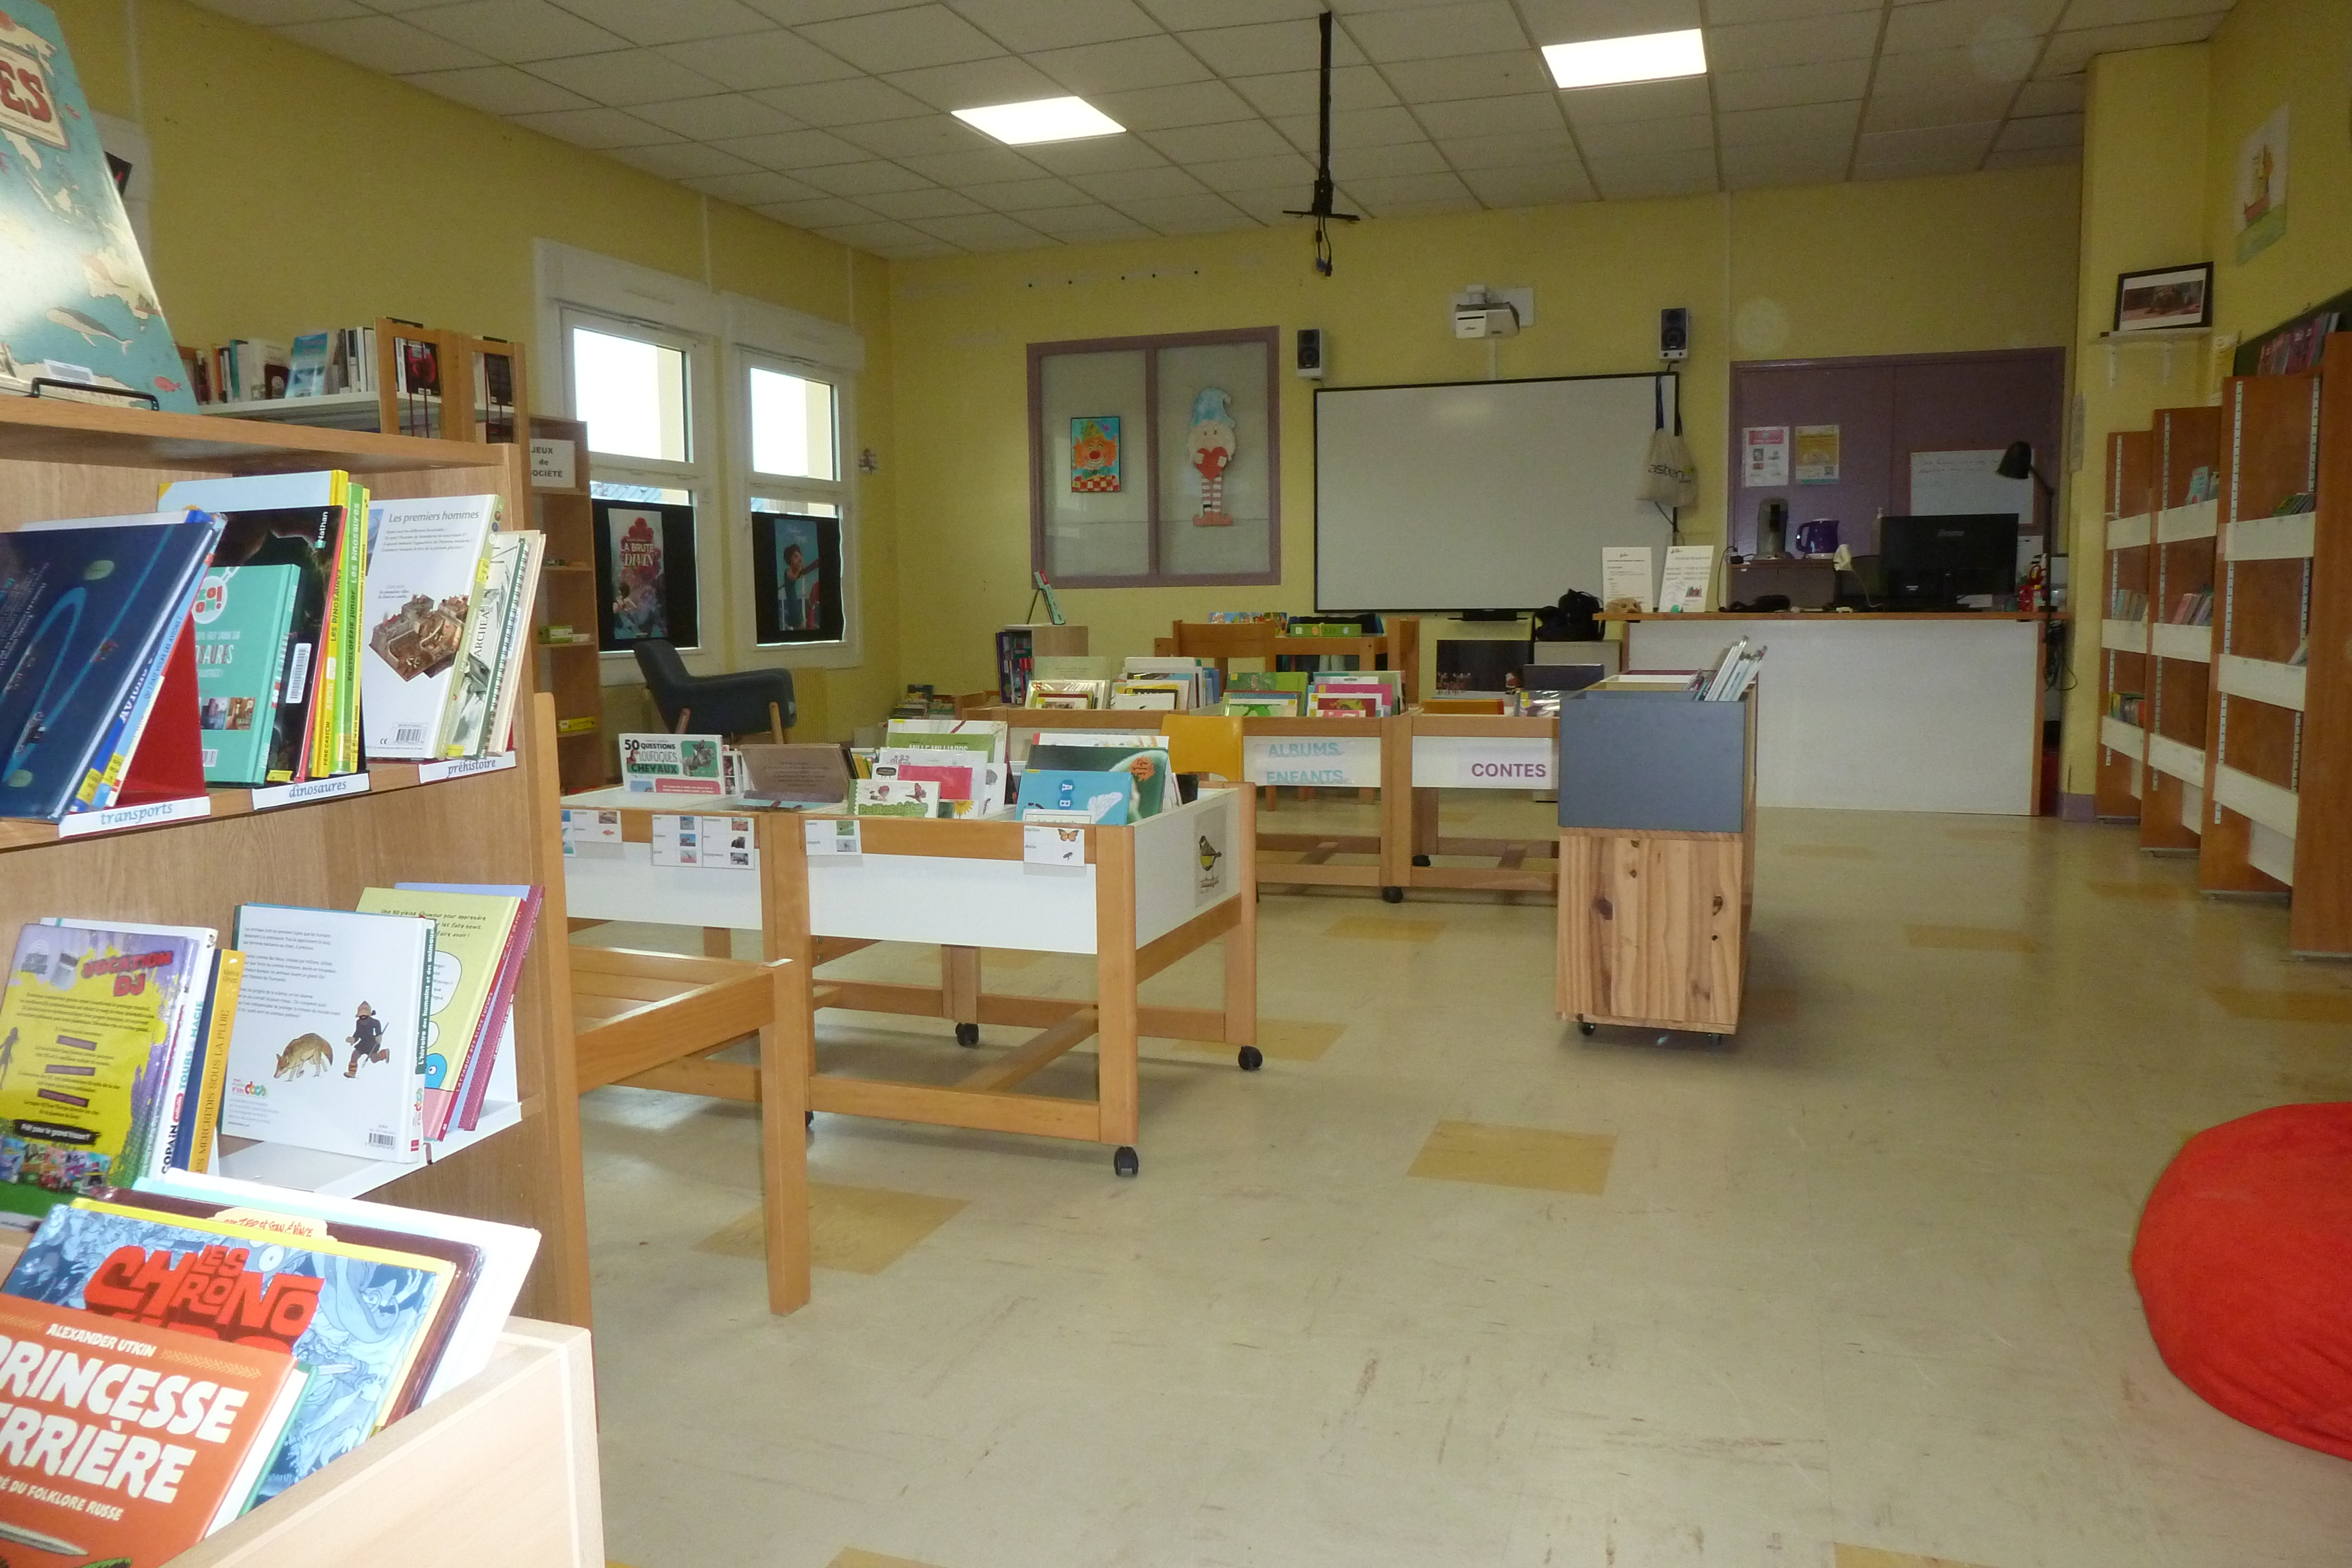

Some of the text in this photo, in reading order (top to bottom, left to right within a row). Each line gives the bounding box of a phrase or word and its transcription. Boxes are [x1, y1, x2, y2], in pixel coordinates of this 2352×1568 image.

[532, 469, 564, 478] OCIÉTÉ
[318, 511, 329, 542] Nathan
[389, 511, 480, 524] Les premiers hommes
[351, 503, 360, 561] Dinosaures
[632, 543, 654, 553] BRUTE
[624, 553, 654, 567] DIVIN
[624, 739, 640, 750] 50
[1269, 742, 1339, 757] ALBUMS
[447, 757, 496, 778] préhistoire
[639, 751, 677, 763] LOUFOQUES
[631, 764, 677, 774] CHEVAUX
[1266, 769, 1343, 785] ENFANTS
[1471, 763, 1546, 778] CONTES
[289, 780, 346, 799] dinosaures
[100, 801, 173, 826] transports
[859, 801, 927, 815] Petites bêtes
[82, 951, 174, 979] VOCATION
[113, 973, 145, 997] DJ
[418, 1031, 426, 1065] L'histoire
[162, 1124, 179, 1175] COPAIN
[179, 1050, 193, 1089] TOURS
[190, 1001, 204, 1038] MAGIE
[195, 1009, 230, 1174] ES MERCREDIS SOUS LA PLUIE
[191, 1245, 250, 1278] LES
[83, 1245, 325, 1337] CHRONO
[46, 1323, 119, 1350] ALEXANDER
[118, 1336, 157, 1357] UTKIN
[8, 1480, 28, 1494] DU
[28, 1485, 86, 1511] FOLKLORE
[85, 1500, 124, 1521] RUSSE
